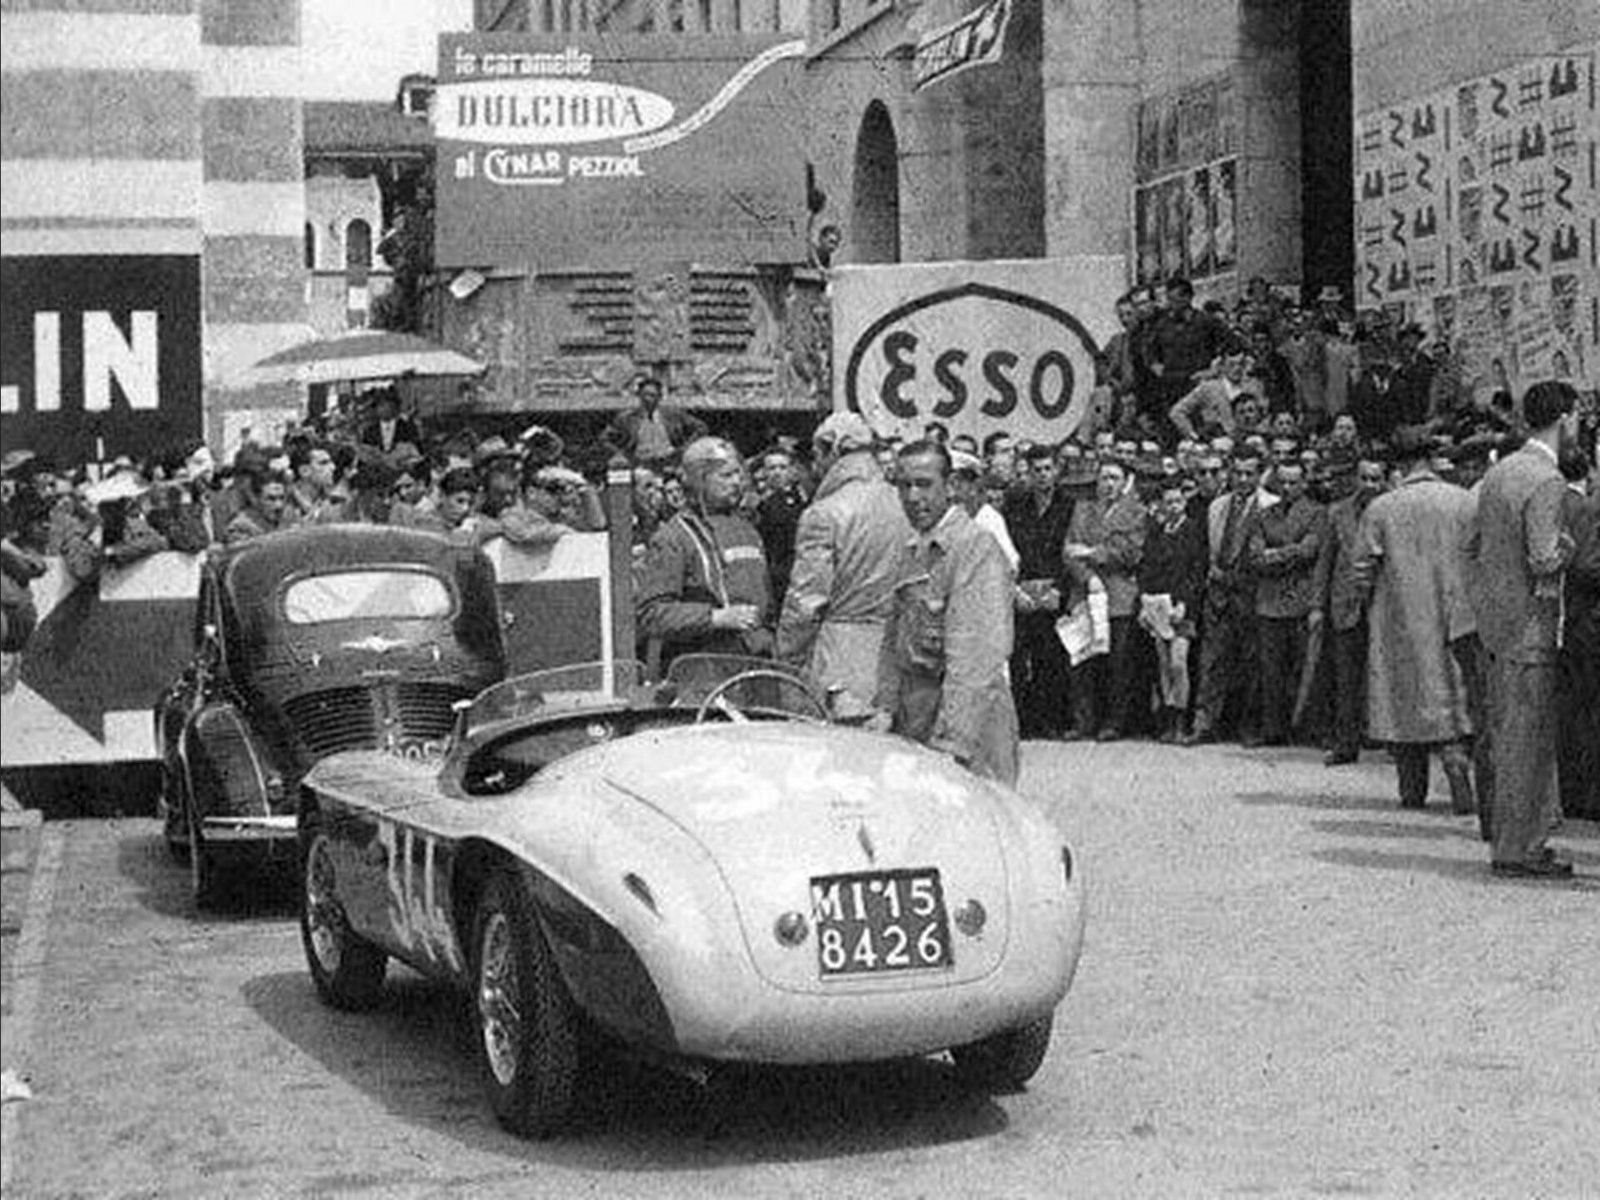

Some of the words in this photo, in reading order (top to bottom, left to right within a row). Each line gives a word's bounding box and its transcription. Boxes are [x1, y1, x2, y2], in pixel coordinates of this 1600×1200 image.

[482, 46, 593, 76] caramelle
[457, 95, 645, 128] DULCIORA
[880, 330, 1075, 419] ESSO
[822, 922, 942, 969] 8426
